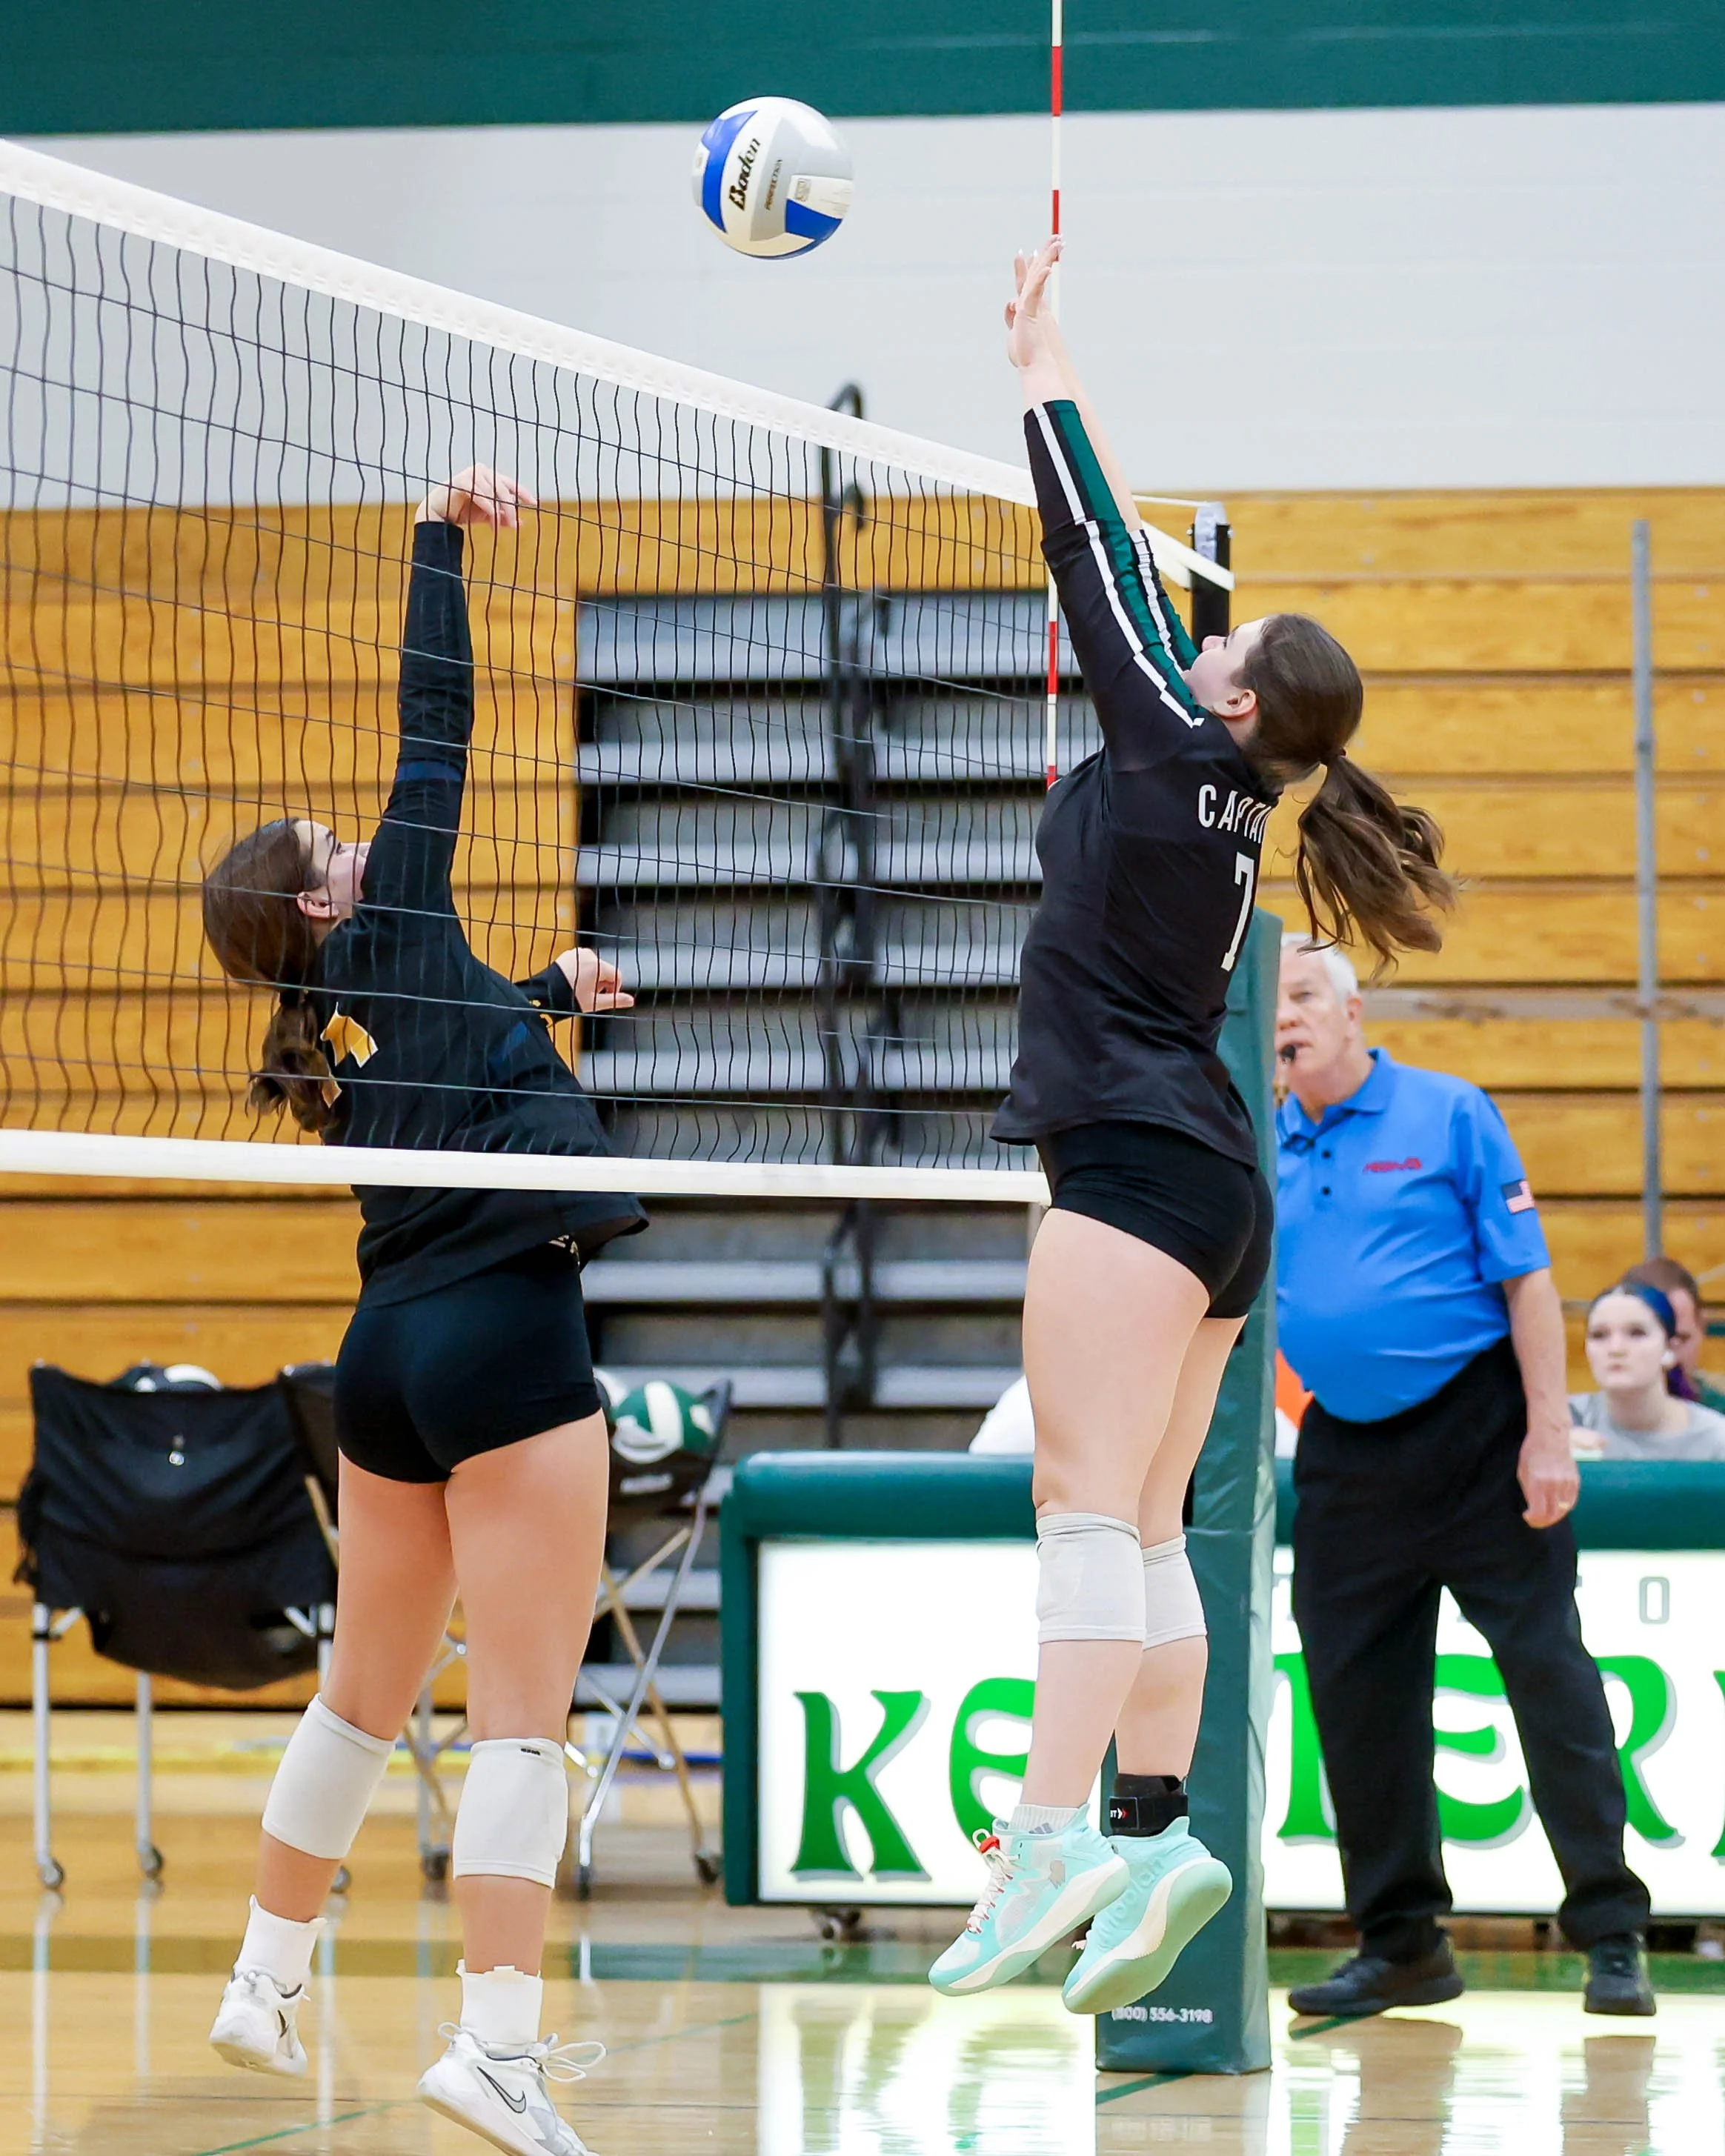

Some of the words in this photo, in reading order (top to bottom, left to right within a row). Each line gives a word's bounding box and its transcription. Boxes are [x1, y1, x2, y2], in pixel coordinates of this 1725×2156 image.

[728, 138, 761, 211] Baden
[1220, 851, 1254, 971] 7
[1149, 2006, 1213, 2023] 556-3198
